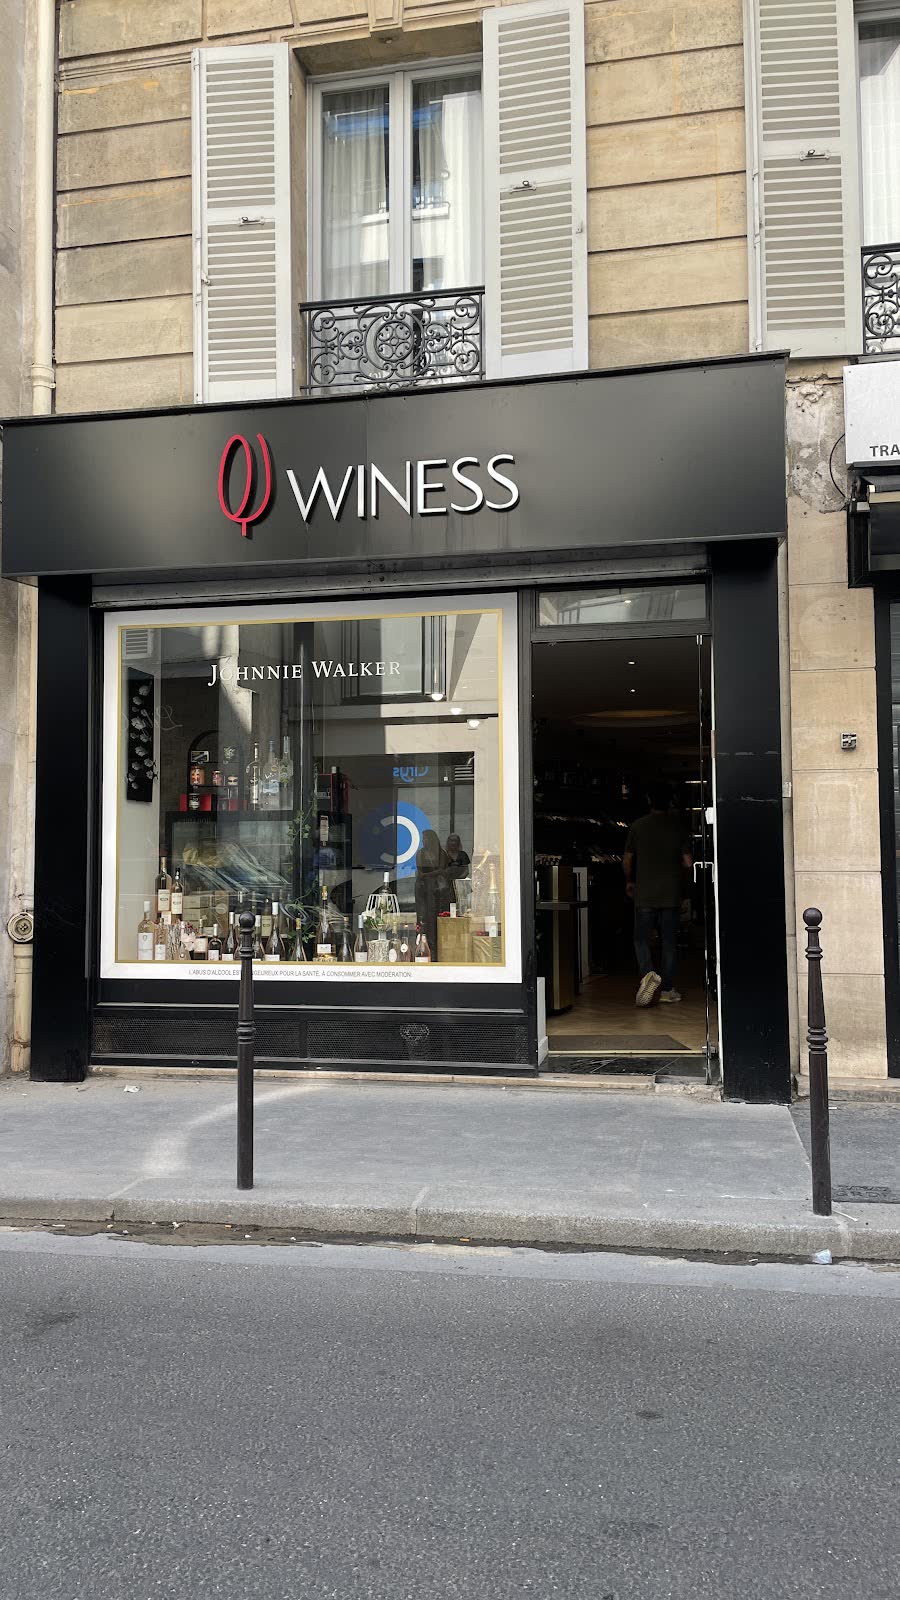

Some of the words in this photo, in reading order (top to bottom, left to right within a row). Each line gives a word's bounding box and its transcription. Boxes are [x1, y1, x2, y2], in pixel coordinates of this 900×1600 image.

[869, 444, 900, 457] TRA
[286, 454, 520, 523] WINESS
[207, 664, 302, 687] JOHNNIE
[311, 660, 401, 679] WALKER
